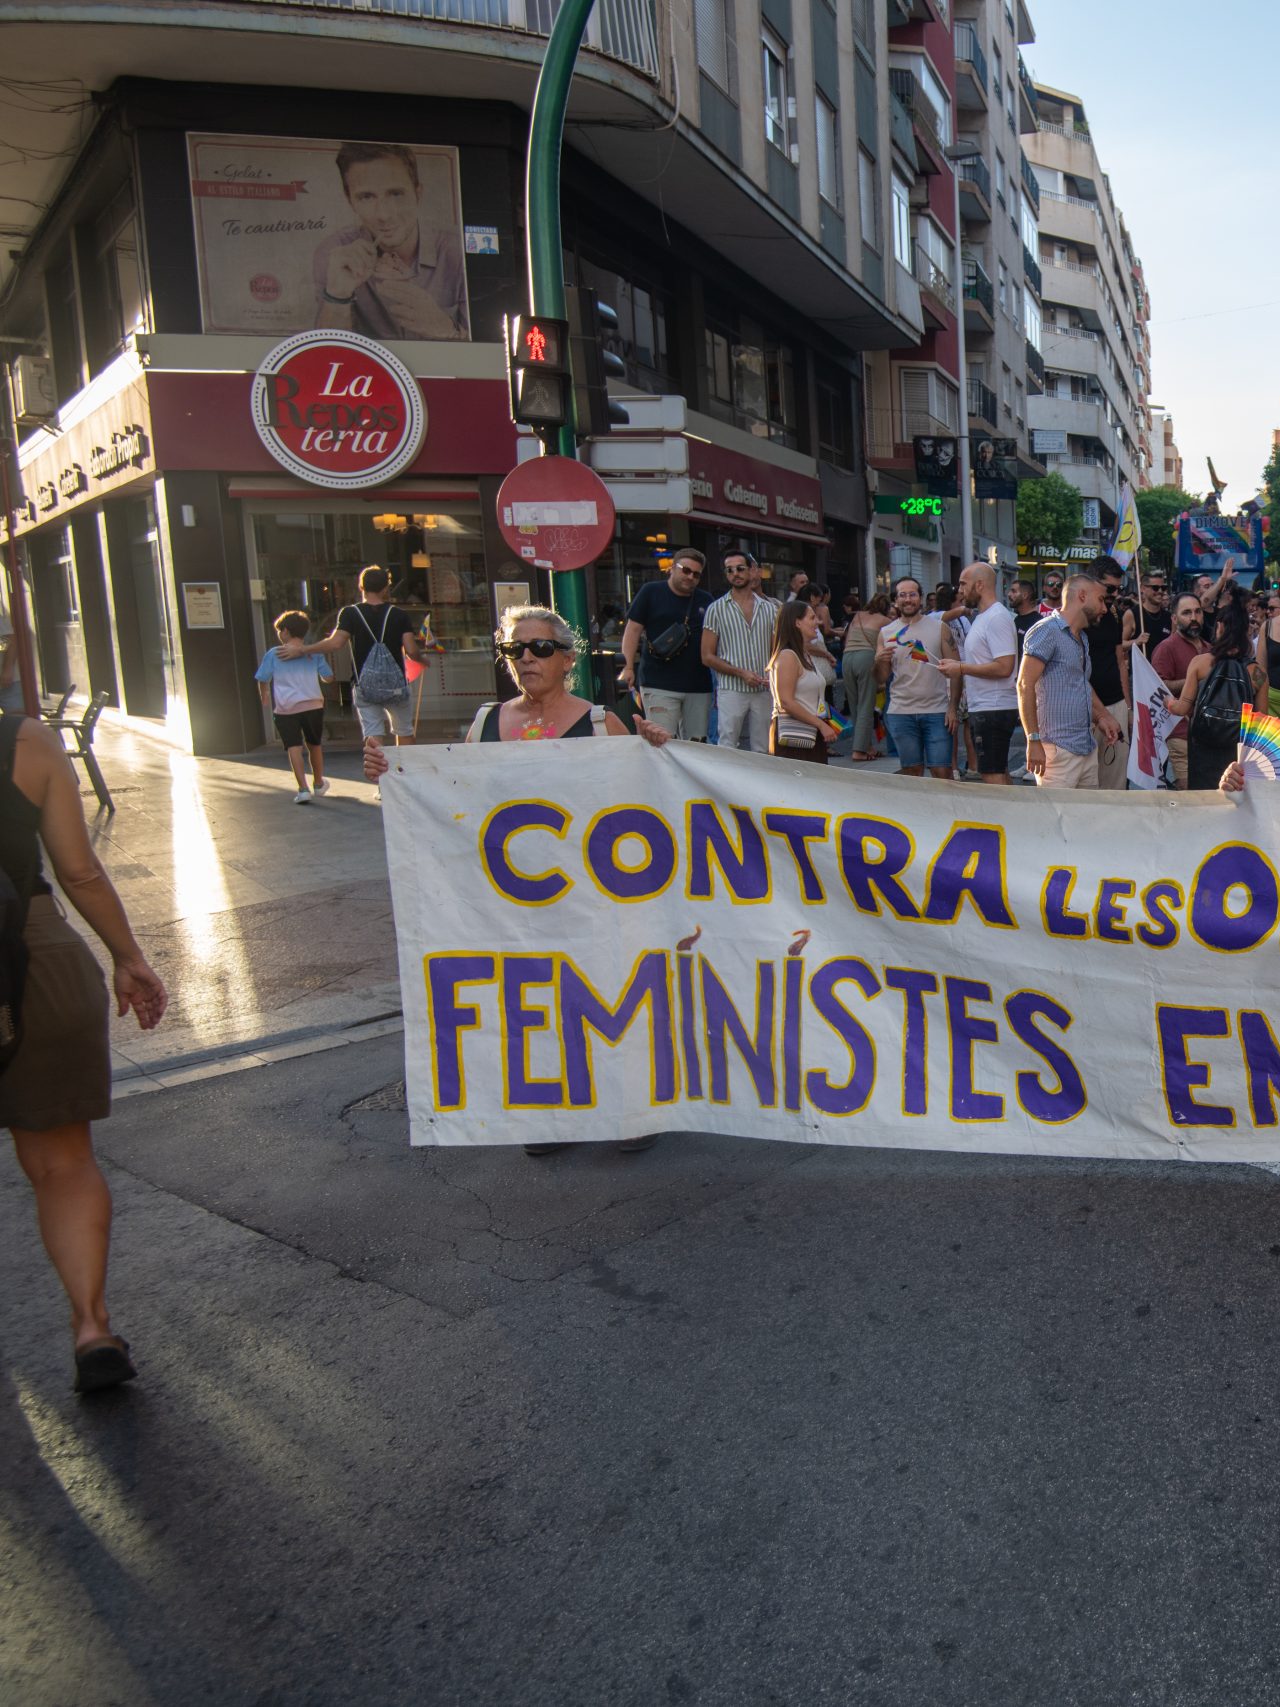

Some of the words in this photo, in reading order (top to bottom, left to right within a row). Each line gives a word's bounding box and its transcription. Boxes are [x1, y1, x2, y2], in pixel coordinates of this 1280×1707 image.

[222, 219, 242, 237] Te
[244, 216, 327, 236] cautivará
[318, 362, 374, 398] La
[258, 373, 400, 442] Repos
[300, 419, 389, 454] tería
[691, 471, 713, 499] eria
[479, 798, 1019, 929] CONTRA
[1040, 865, 1185, 950] LES
